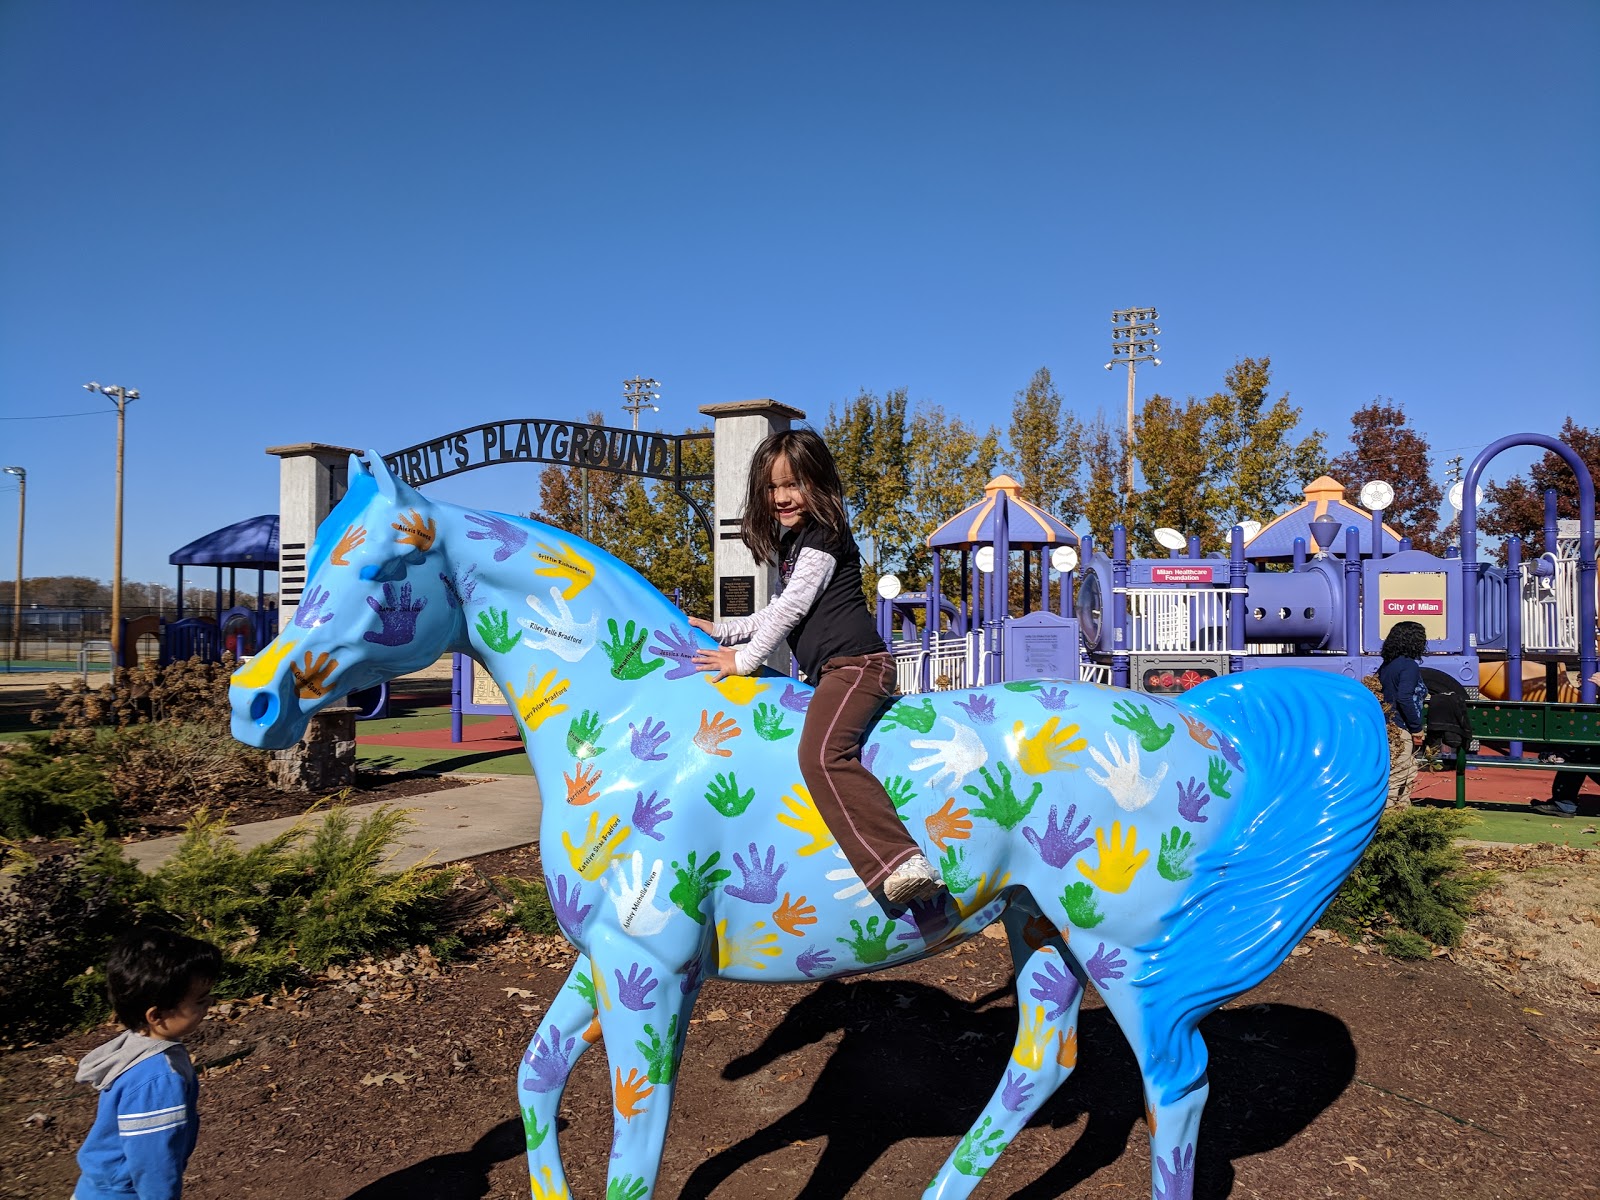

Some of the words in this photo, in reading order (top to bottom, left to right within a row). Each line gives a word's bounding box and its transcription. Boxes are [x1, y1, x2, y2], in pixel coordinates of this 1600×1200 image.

[386, 434, 469, 483] PIRIT'S
[482, 422, 668, 474] PLAYGROUND
[1388, 603, 1404, 612] City
[1407, 603, 1415, 611] of
[1418, 603, 1439, 611] Milan
[530, 622, 543, 632] Riley
[557, 631, 582, 644] Bradford
[543, 686, 568, 703] Bradford
[601, 817, 621, 841] Bradford
[631, 887, 649, 912] Michelle
